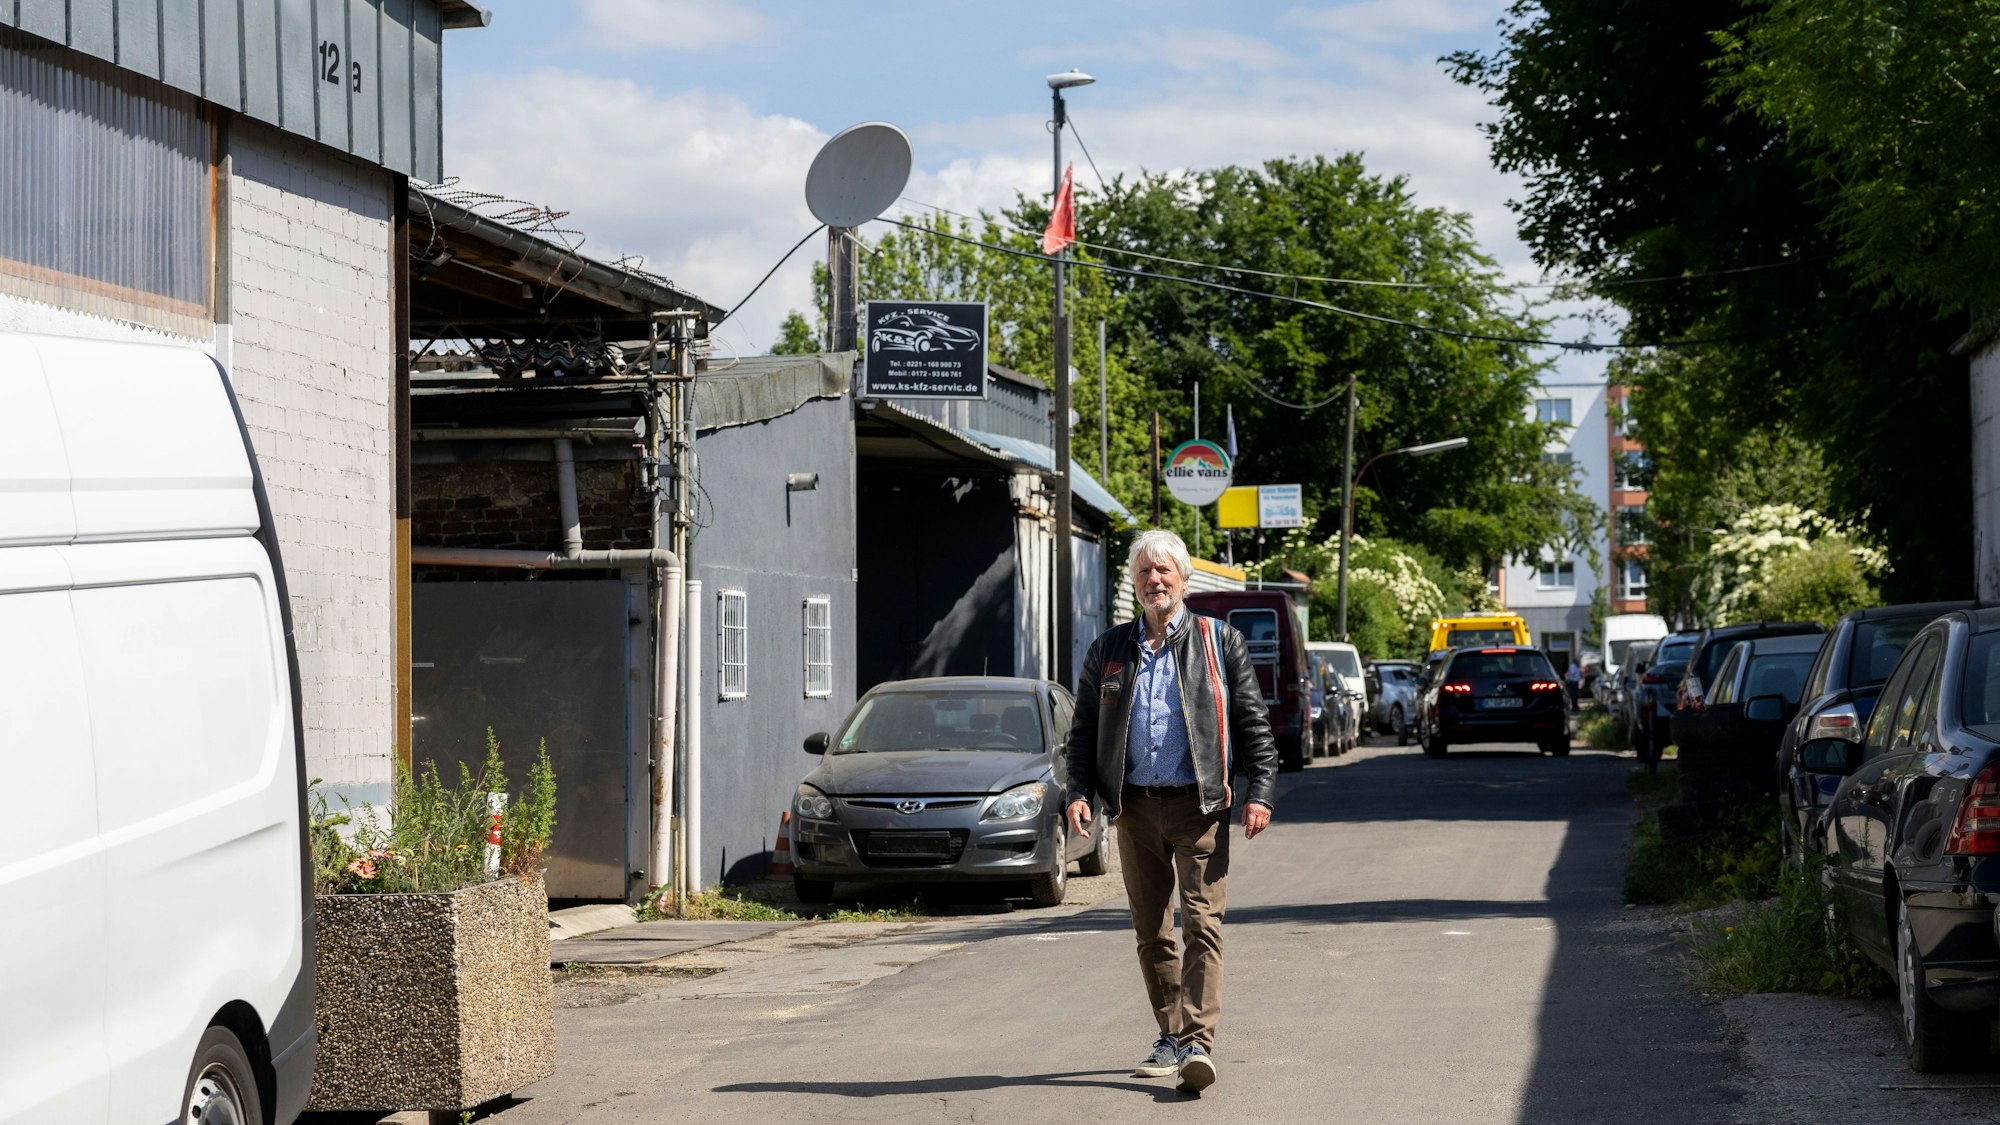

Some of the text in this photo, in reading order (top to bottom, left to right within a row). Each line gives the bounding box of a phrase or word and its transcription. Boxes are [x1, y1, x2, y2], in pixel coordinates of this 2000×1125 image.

[319, 40, 361, 94] 12 a
[877, 311, 899, 325] KFZ
[907, 308, 951, 322] SERVICE
[881, 333, 915, 346] K&S
[906, 360, 922, 368] 0221
[888, 369, 907, 377] Mobil
[911, 370, 928, 378] 0172
[871, 382, 978, 393] www.ks-kfz-servic.de
[1166, 465, 1229, 478] ellie vans
